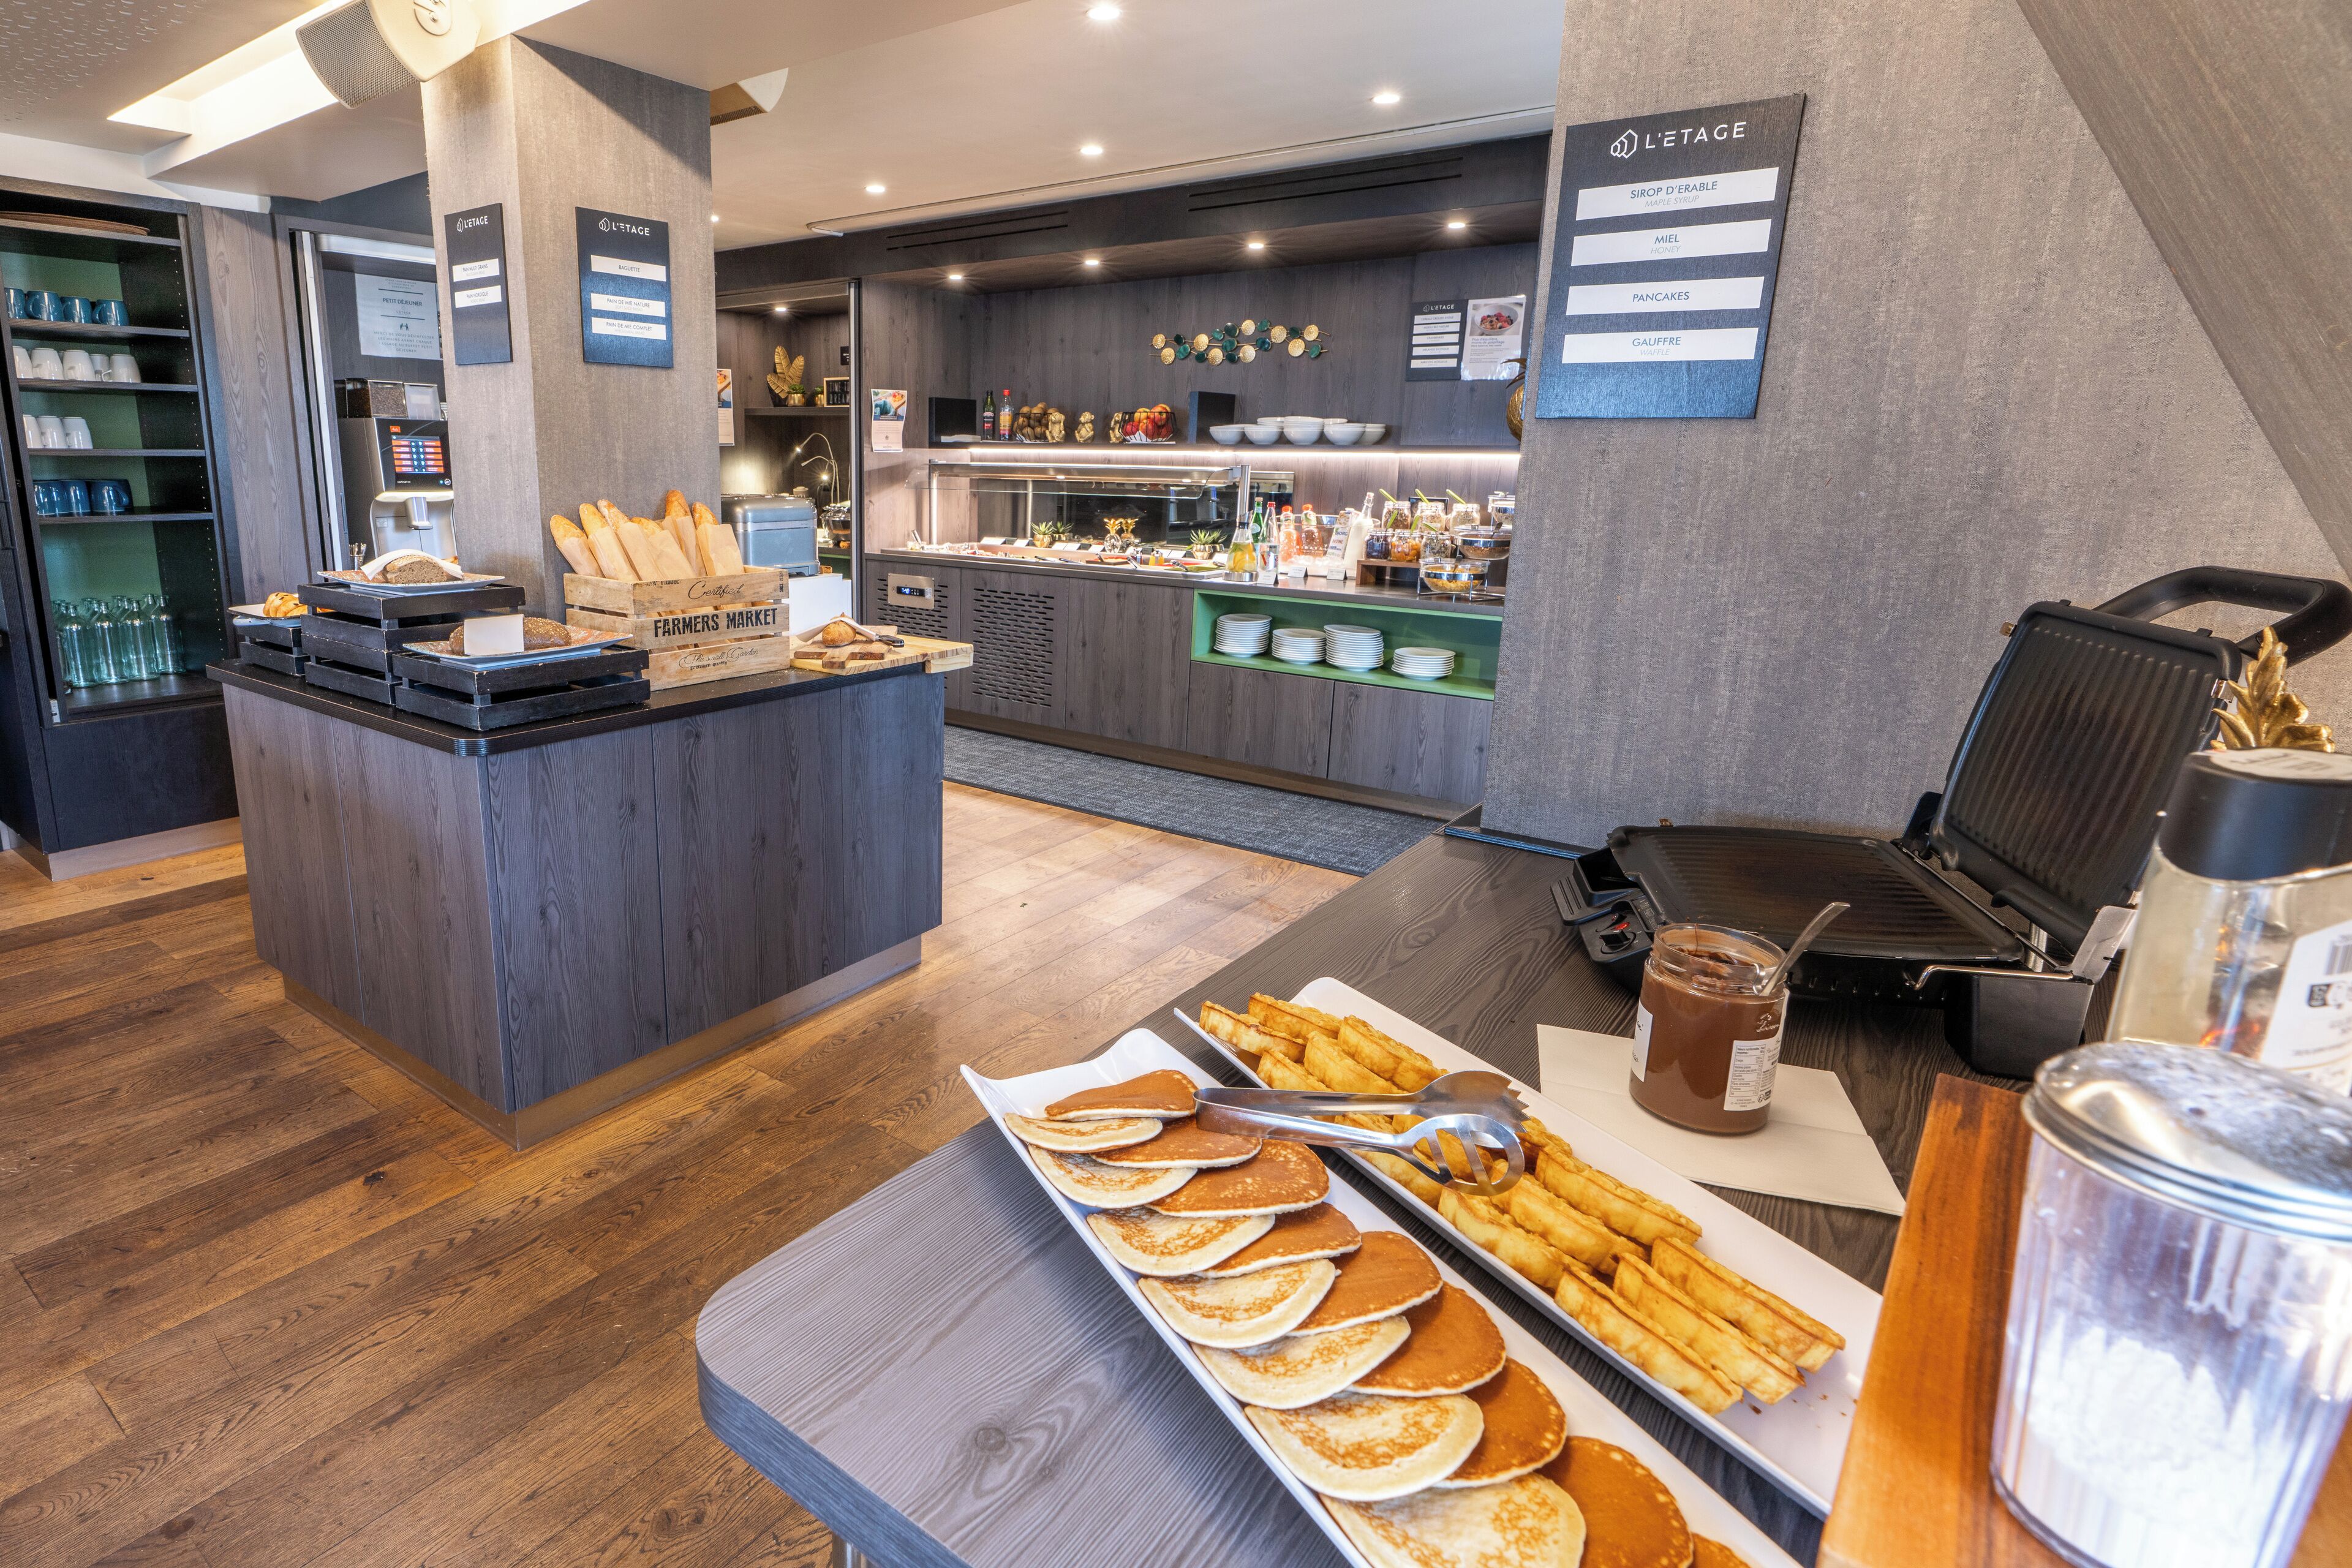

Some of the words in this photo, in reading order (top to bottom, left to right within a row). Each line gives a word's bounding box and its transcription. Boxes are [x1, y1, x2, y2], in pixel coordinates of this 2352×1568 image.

[1645, 122, 1746, 149] L'ETAGE
[1630, 187, 1663, 199] SIROP
[1645, 198, 1671, 208] MAPLE
[1673, 195, 1700, 205] SYRUP
[464, 216, 488, 228] L'ETAGE
[612, 222, 650, 236] L'ETAGE
[1654, 234, 1679, 244] MIEL
[1651, 246, 1681, 254] HONEY
[1632, 292, 1689, 303] PANCAKES
[1632, 337, 1681, 347] GAUFFRE
[829, 382, 841, 392] TIME
[688, 581, 744, 600] Certified
[654, 614, 720, 638] FARMERS
[726, 608, 778, 630] MARKET
[679, 653, 704, 669] The
[726, 647, 759, 663] Garden
